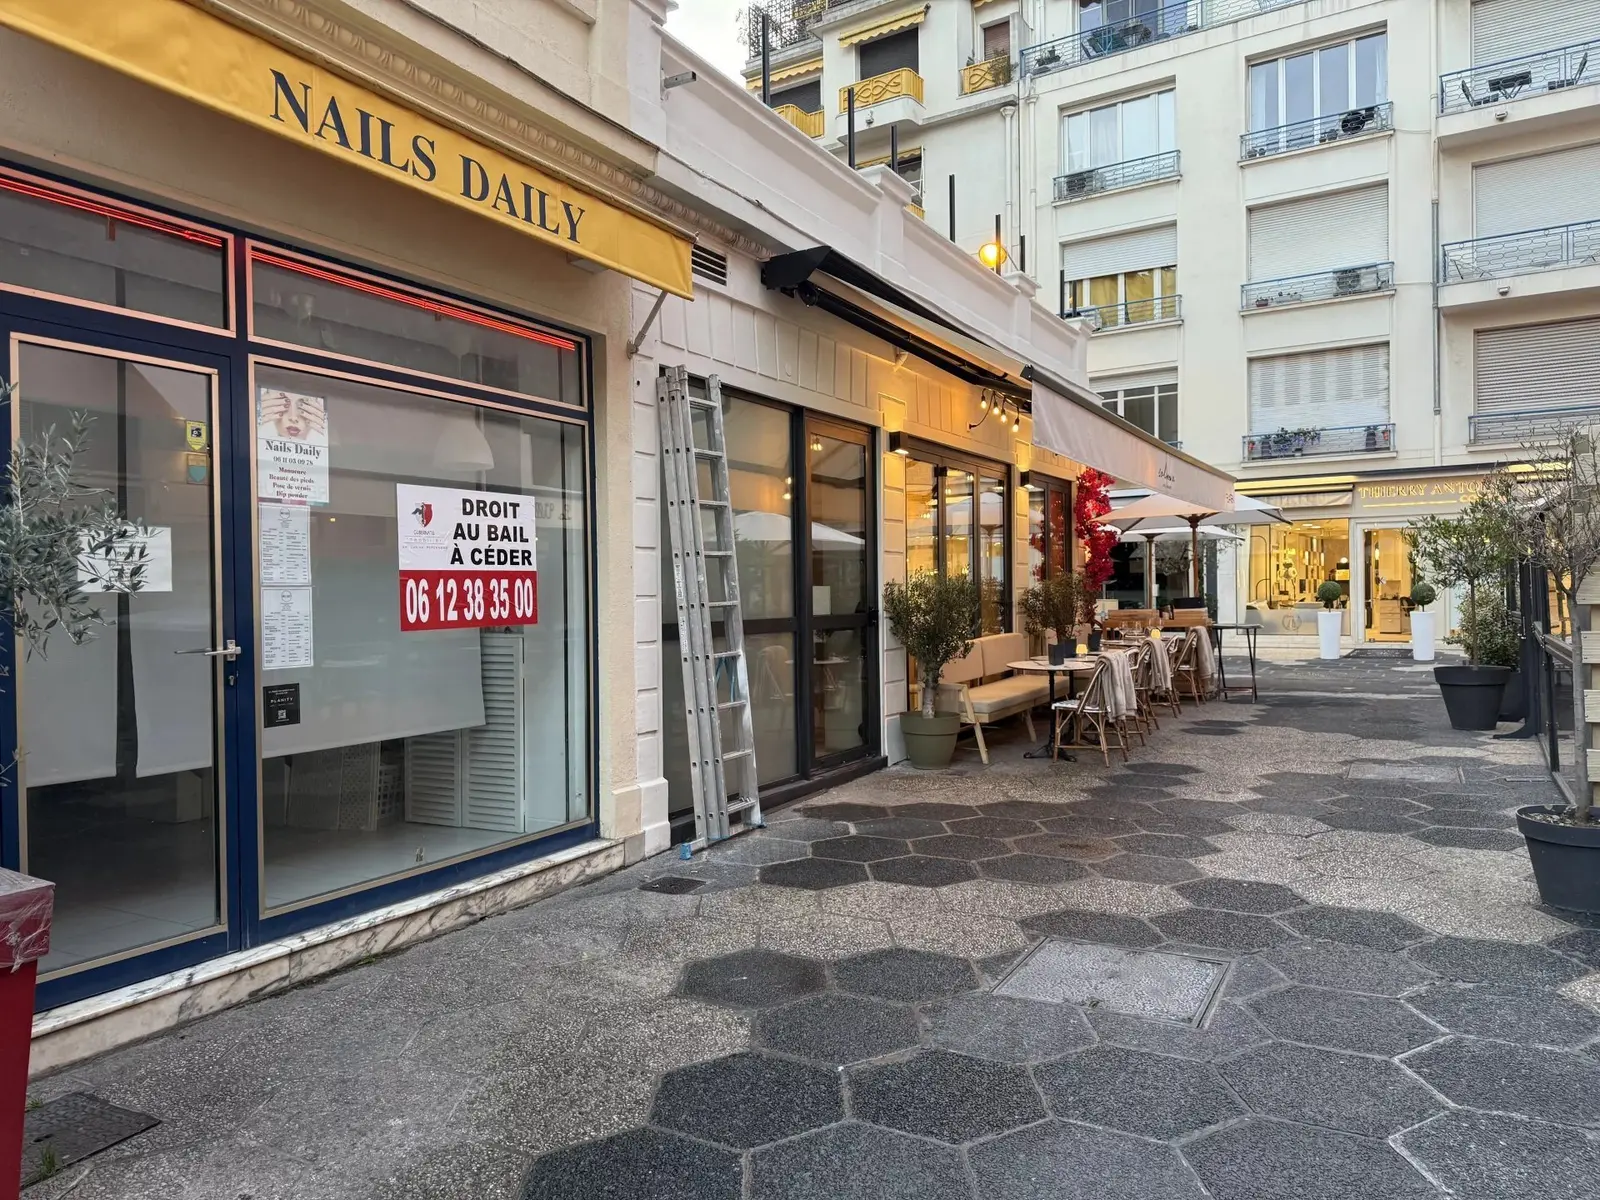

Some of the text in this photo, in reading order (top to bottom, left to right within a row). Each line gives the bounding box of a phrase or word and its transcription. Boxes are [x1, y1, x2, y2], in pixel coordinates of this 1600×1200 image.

[269, 68, 585, 244] NAILS DAILY
[265, 440, 321, 459] Nails Daily
[269, 473, 288, 481] Beauté
[276, 490, 308, 499] Dip powder
[1358, 484, 1427, 498] THIERRY
[462, 498, 520, 519] DROIT
[453, 522, 529, 543] AU BAIL
[450, 543, 533, 566] À CÉDER
[406, 578, 533, 623] 06 12 38 35 00
